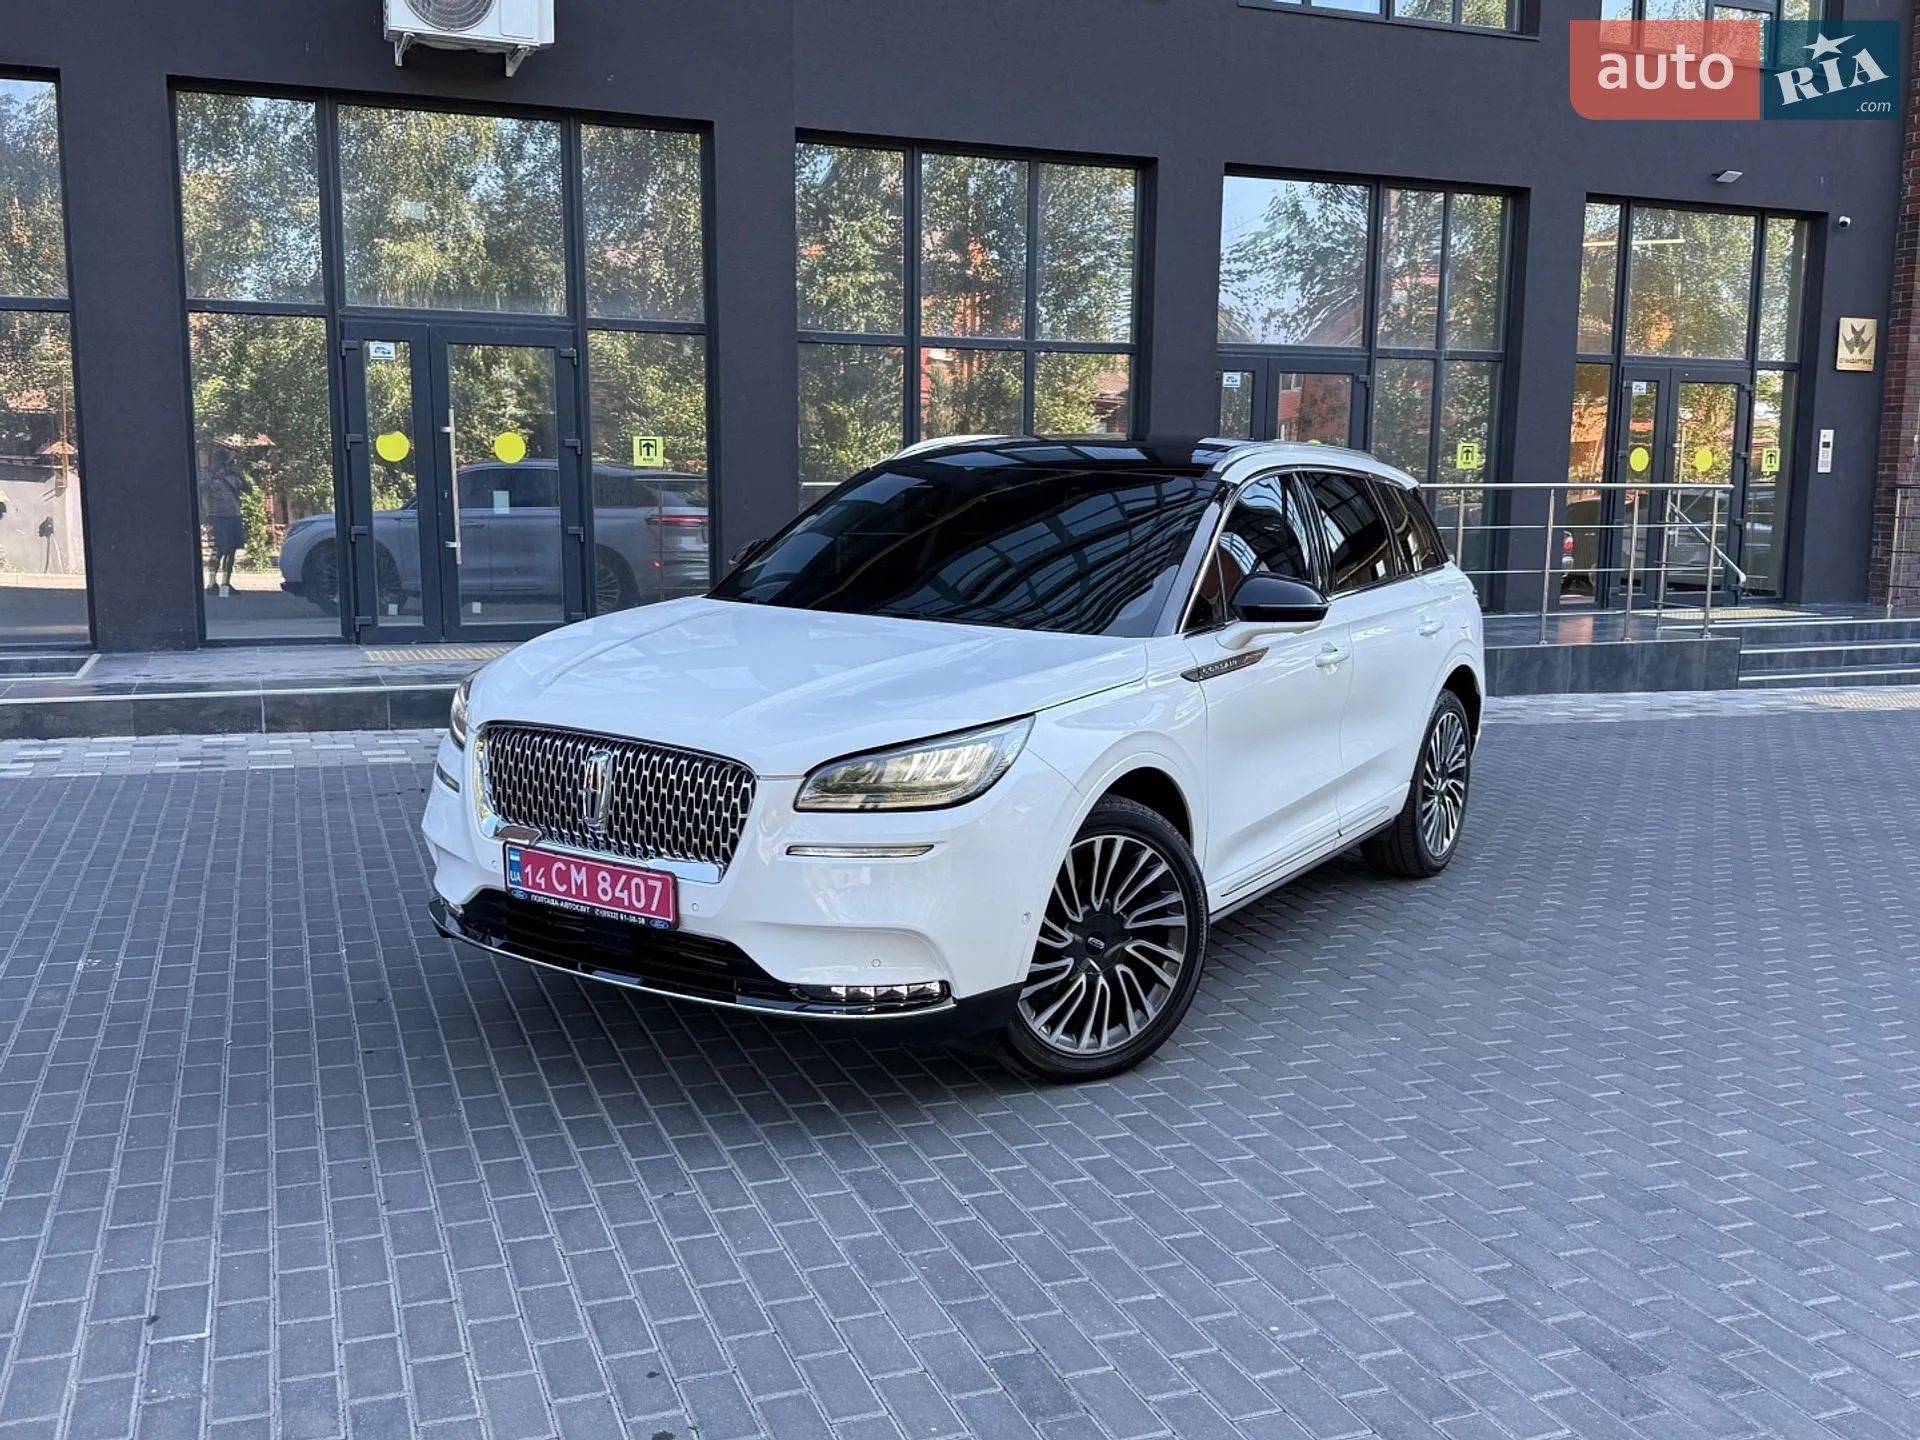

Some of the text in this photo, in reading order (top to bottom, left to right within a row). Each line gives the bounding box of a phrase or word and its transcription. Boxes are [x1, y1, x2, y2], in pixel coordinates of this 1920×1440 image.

[510, 870, 521, 882] UA
[524, 861, 663, 912] 14 CM 8407
